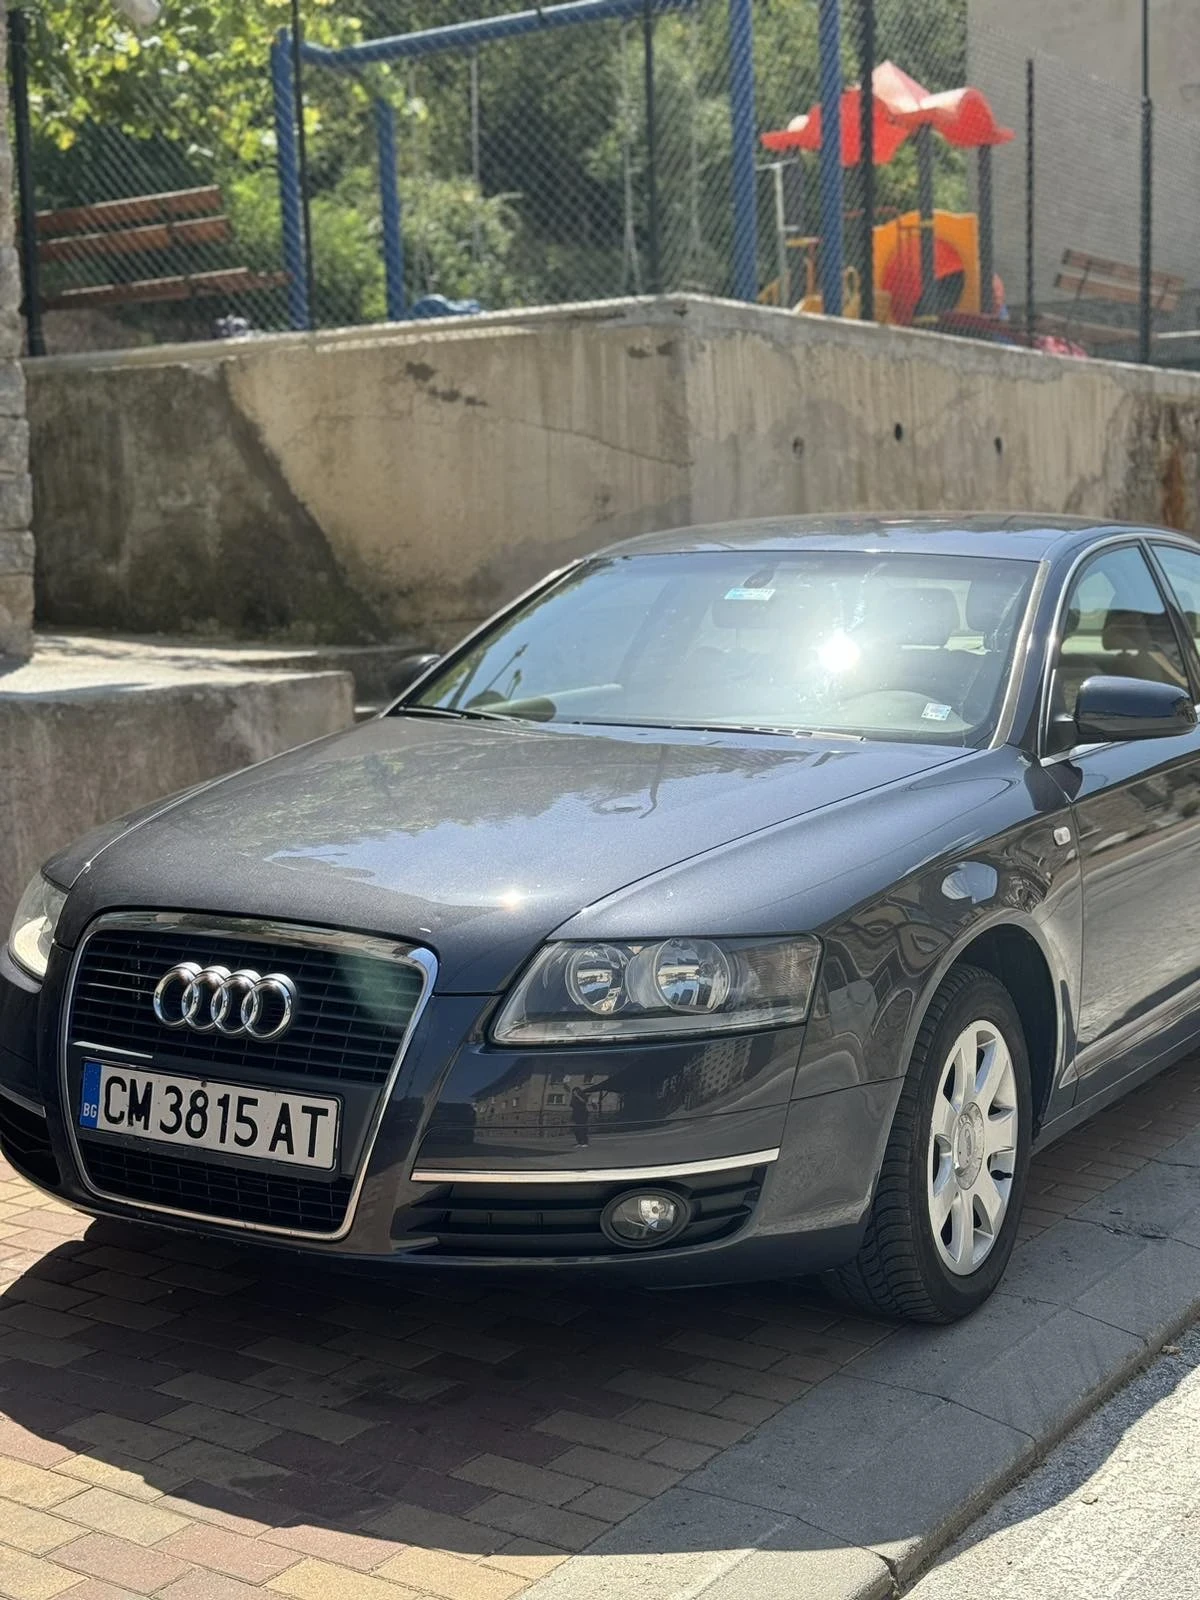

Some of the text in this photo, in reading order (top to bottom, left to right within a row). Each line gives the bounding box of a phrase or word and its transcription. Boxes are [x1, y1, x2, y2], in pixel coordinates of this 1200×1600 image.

[82, 1102, 98, 1119] BG
[104, 1076, 329, 1158] CM 3815 AT
